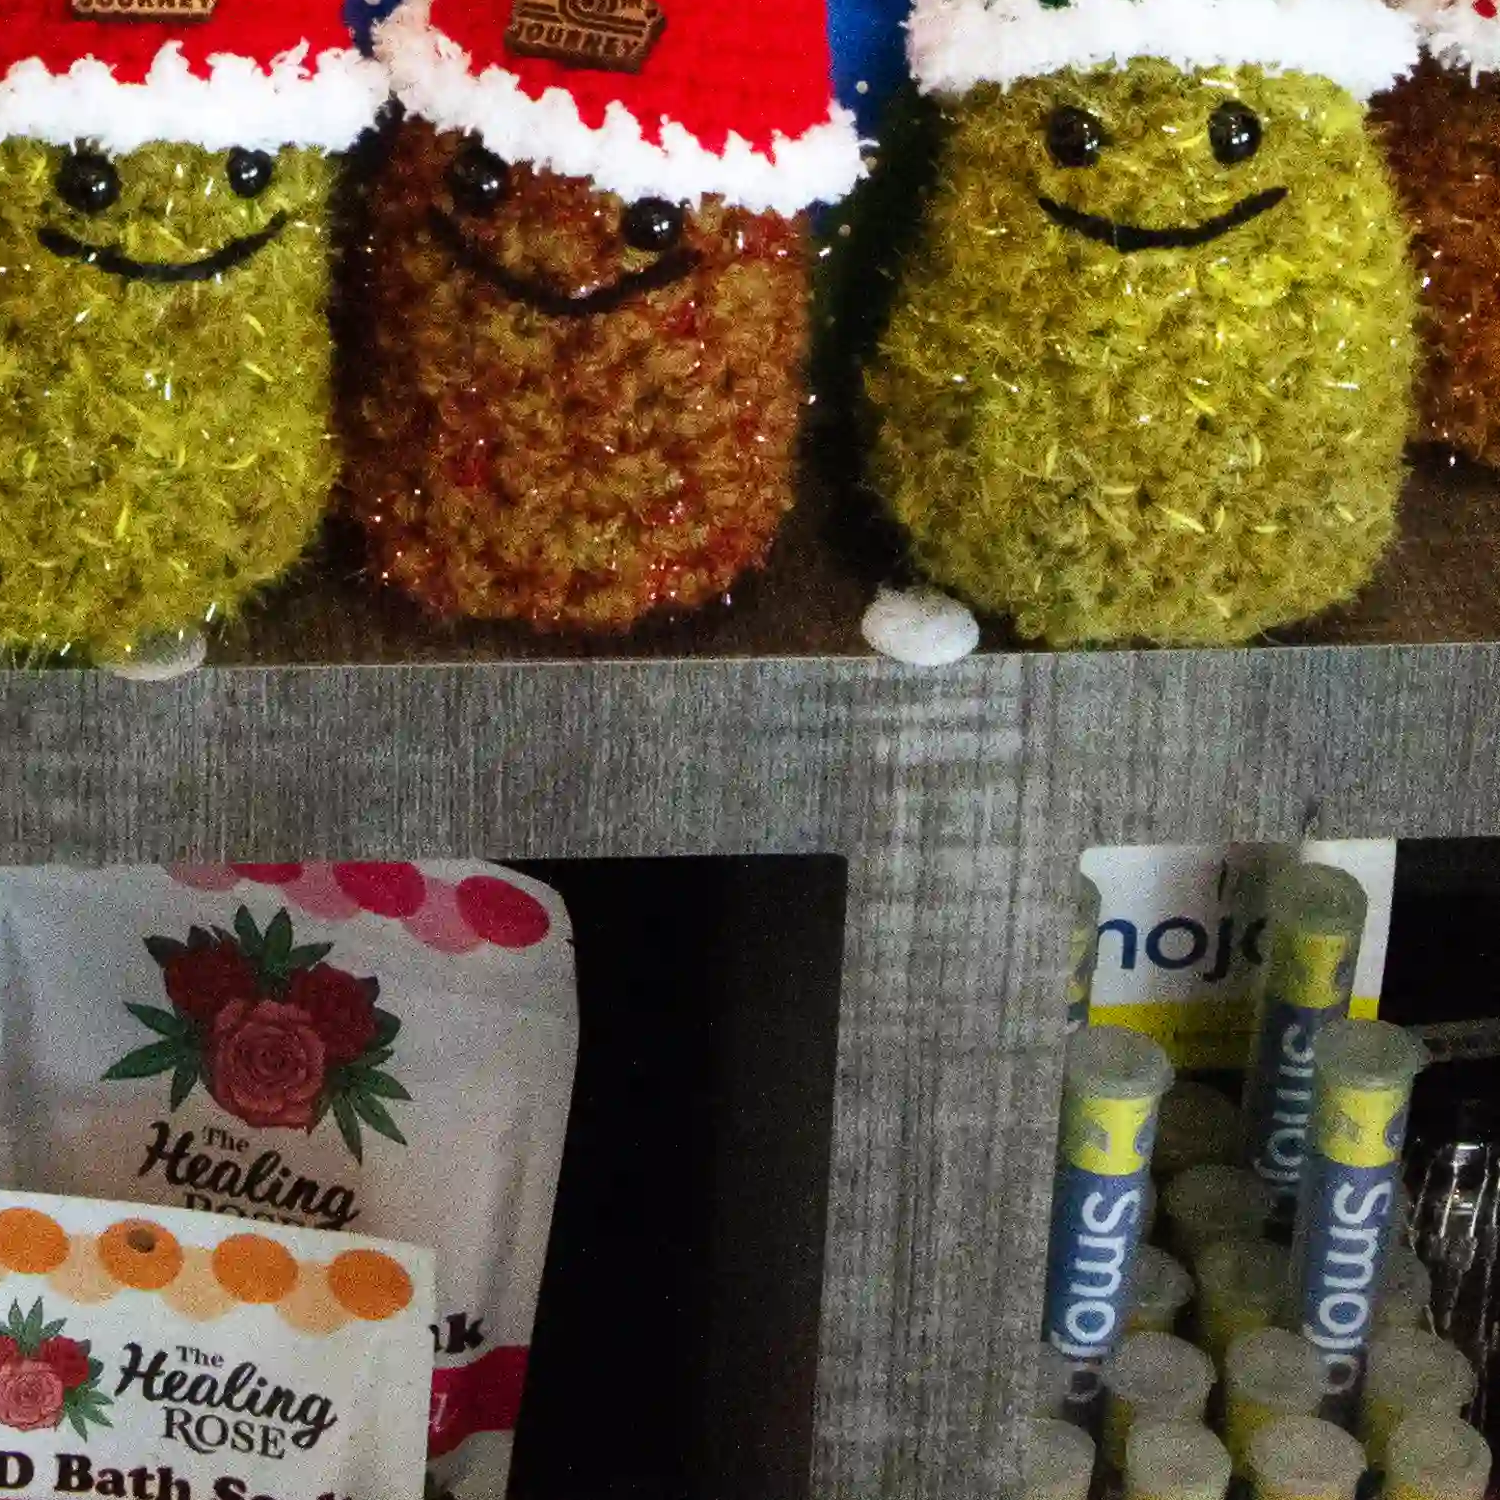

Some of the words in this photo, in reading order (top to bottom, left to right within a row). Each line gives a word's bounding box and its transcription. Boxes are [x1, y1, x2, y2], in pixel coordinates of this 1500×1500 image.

[202, 1125, 250, 1153] The
[137, 1120, 362, 1231] Healing
[175, 1345, 226, 1369] The
[114, 1340, 339, 1450] Healing
[161, 1405, 288, 1460] ROSE
[53, 1451, 191, 1500] Bath
